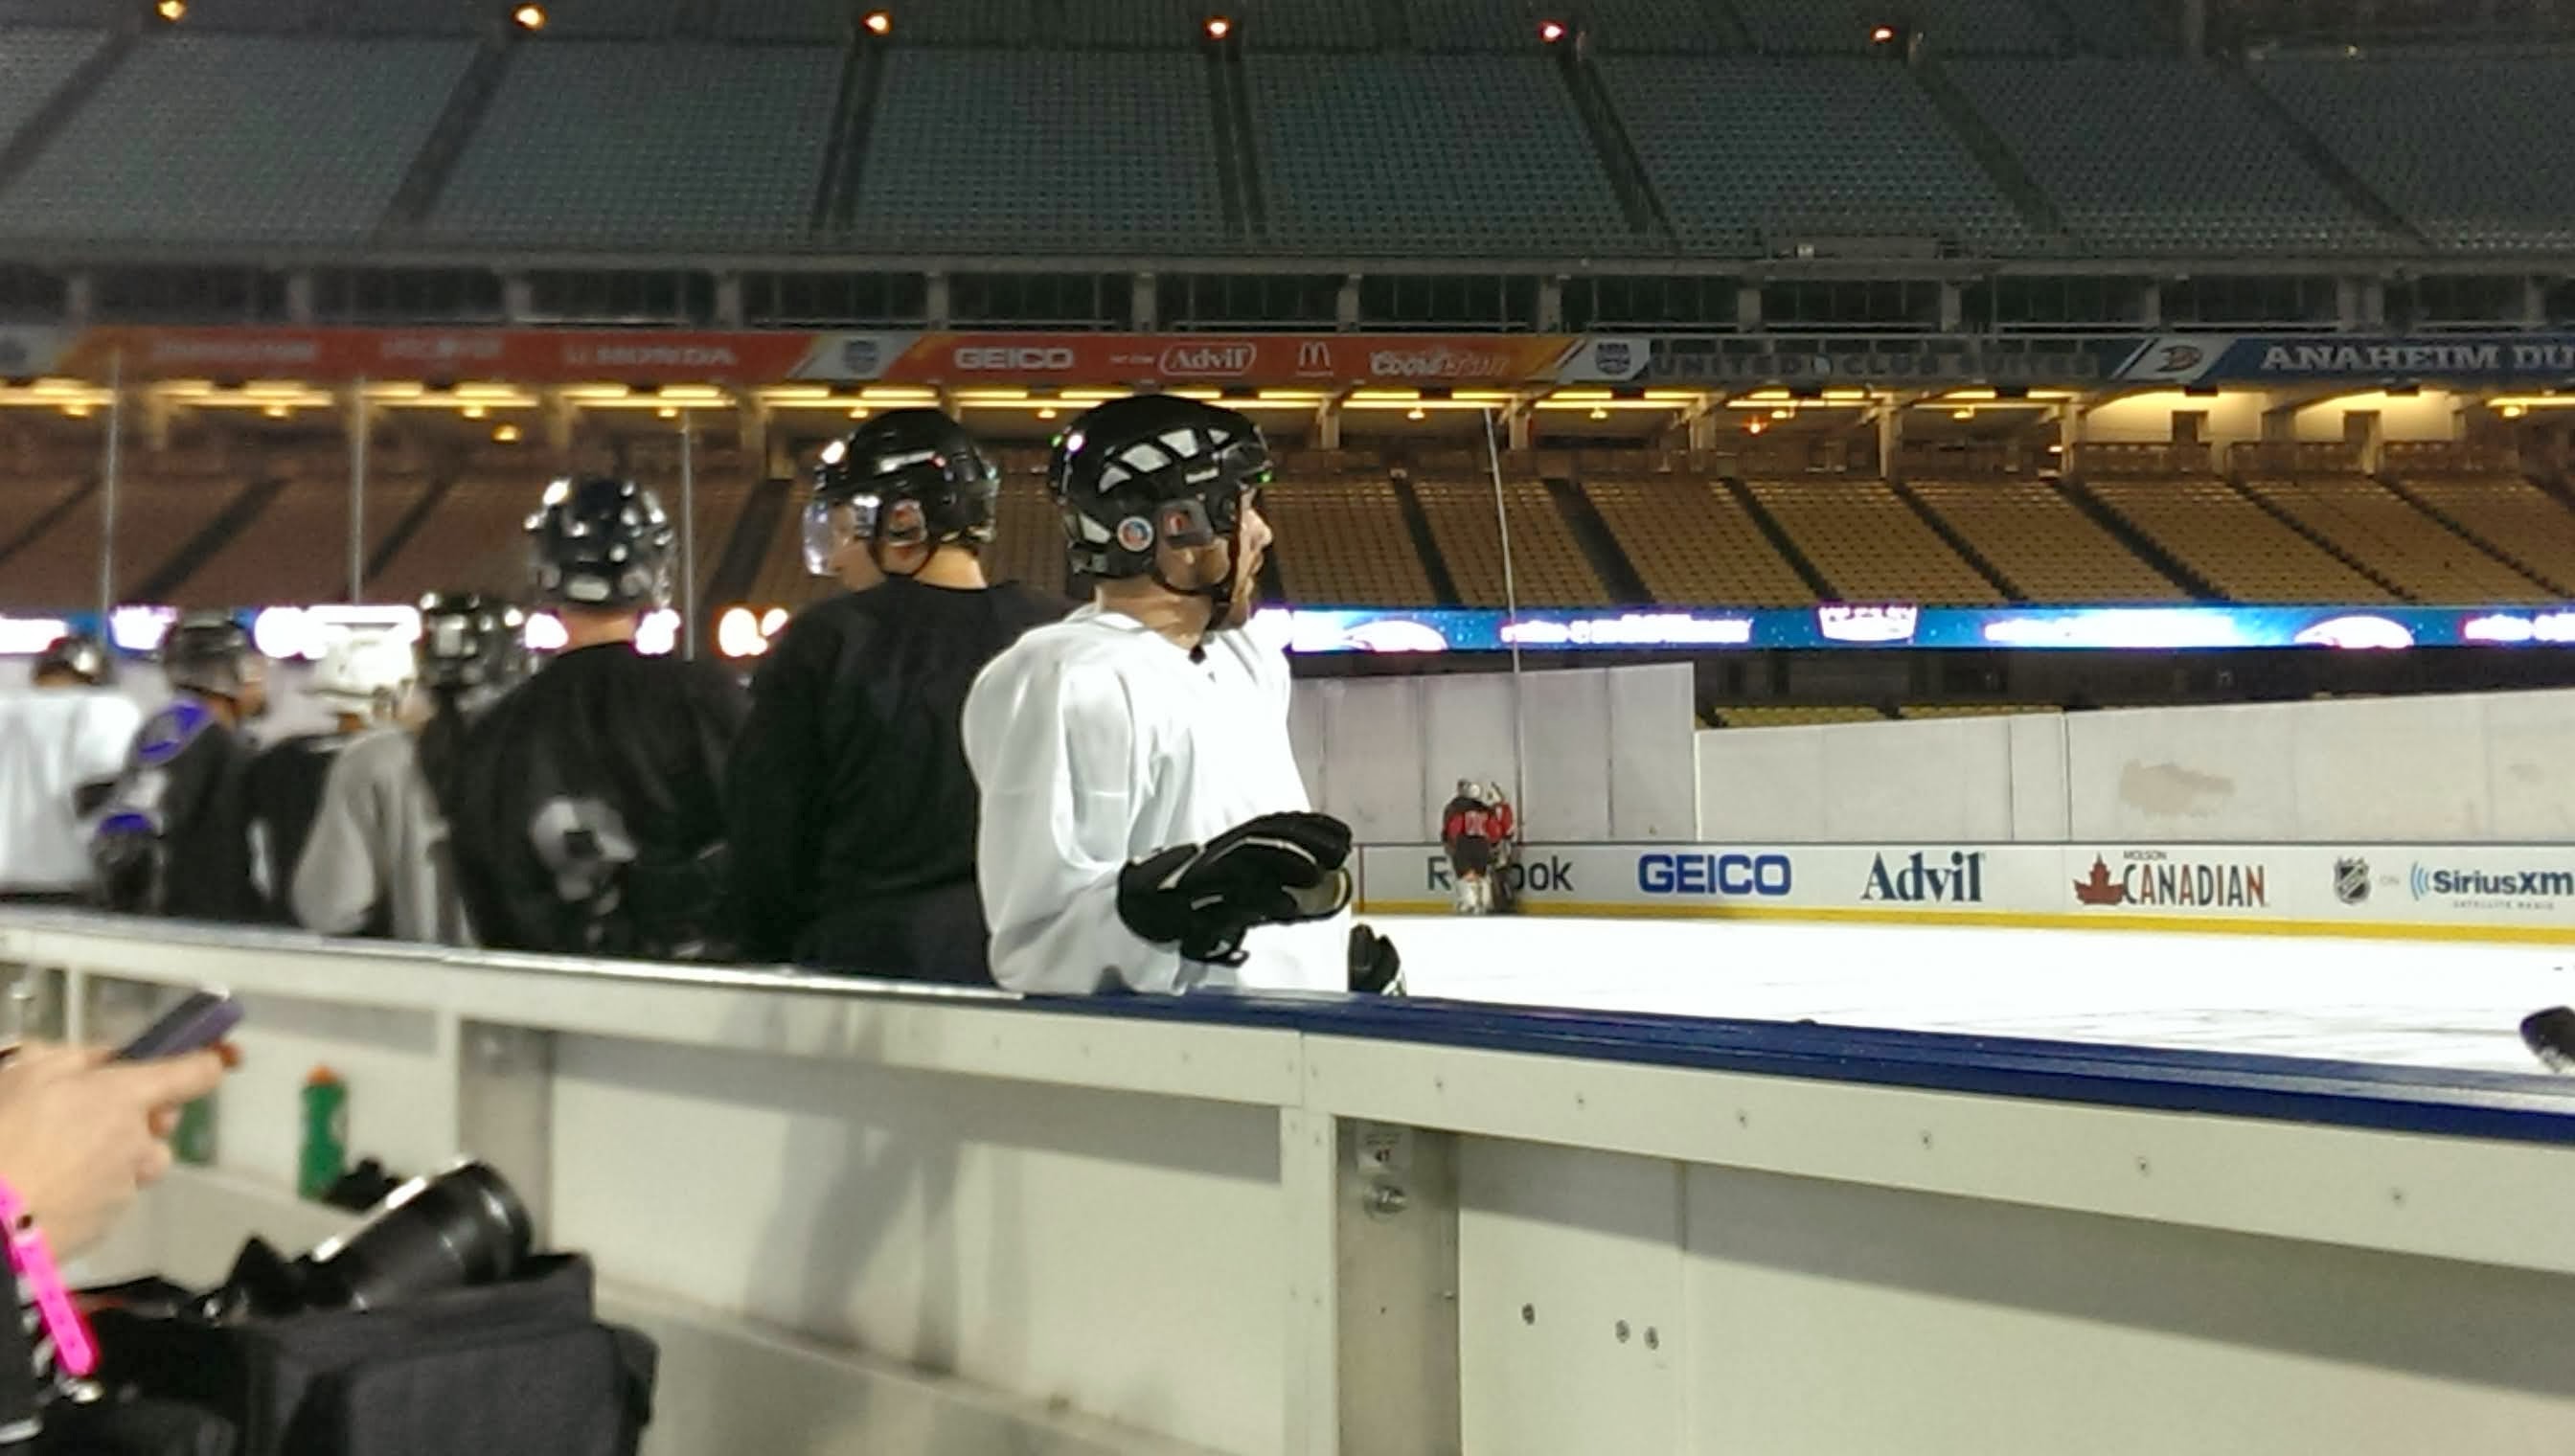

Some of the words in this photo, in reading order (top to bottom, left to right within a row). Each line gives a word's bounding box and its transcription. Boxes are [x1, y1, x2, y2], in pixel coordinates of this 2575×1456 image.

[953, 347, 1073, 371] GEICO
[1170, 347, 1247, 370] Advil
[2260, 345, 2500, 370] ANAHEIM
[1639, 854, 1792, 897] GEICO
[1860, 851, 1982, 902] Advil
[2122, 864, 2266, 907] CANADIAN
